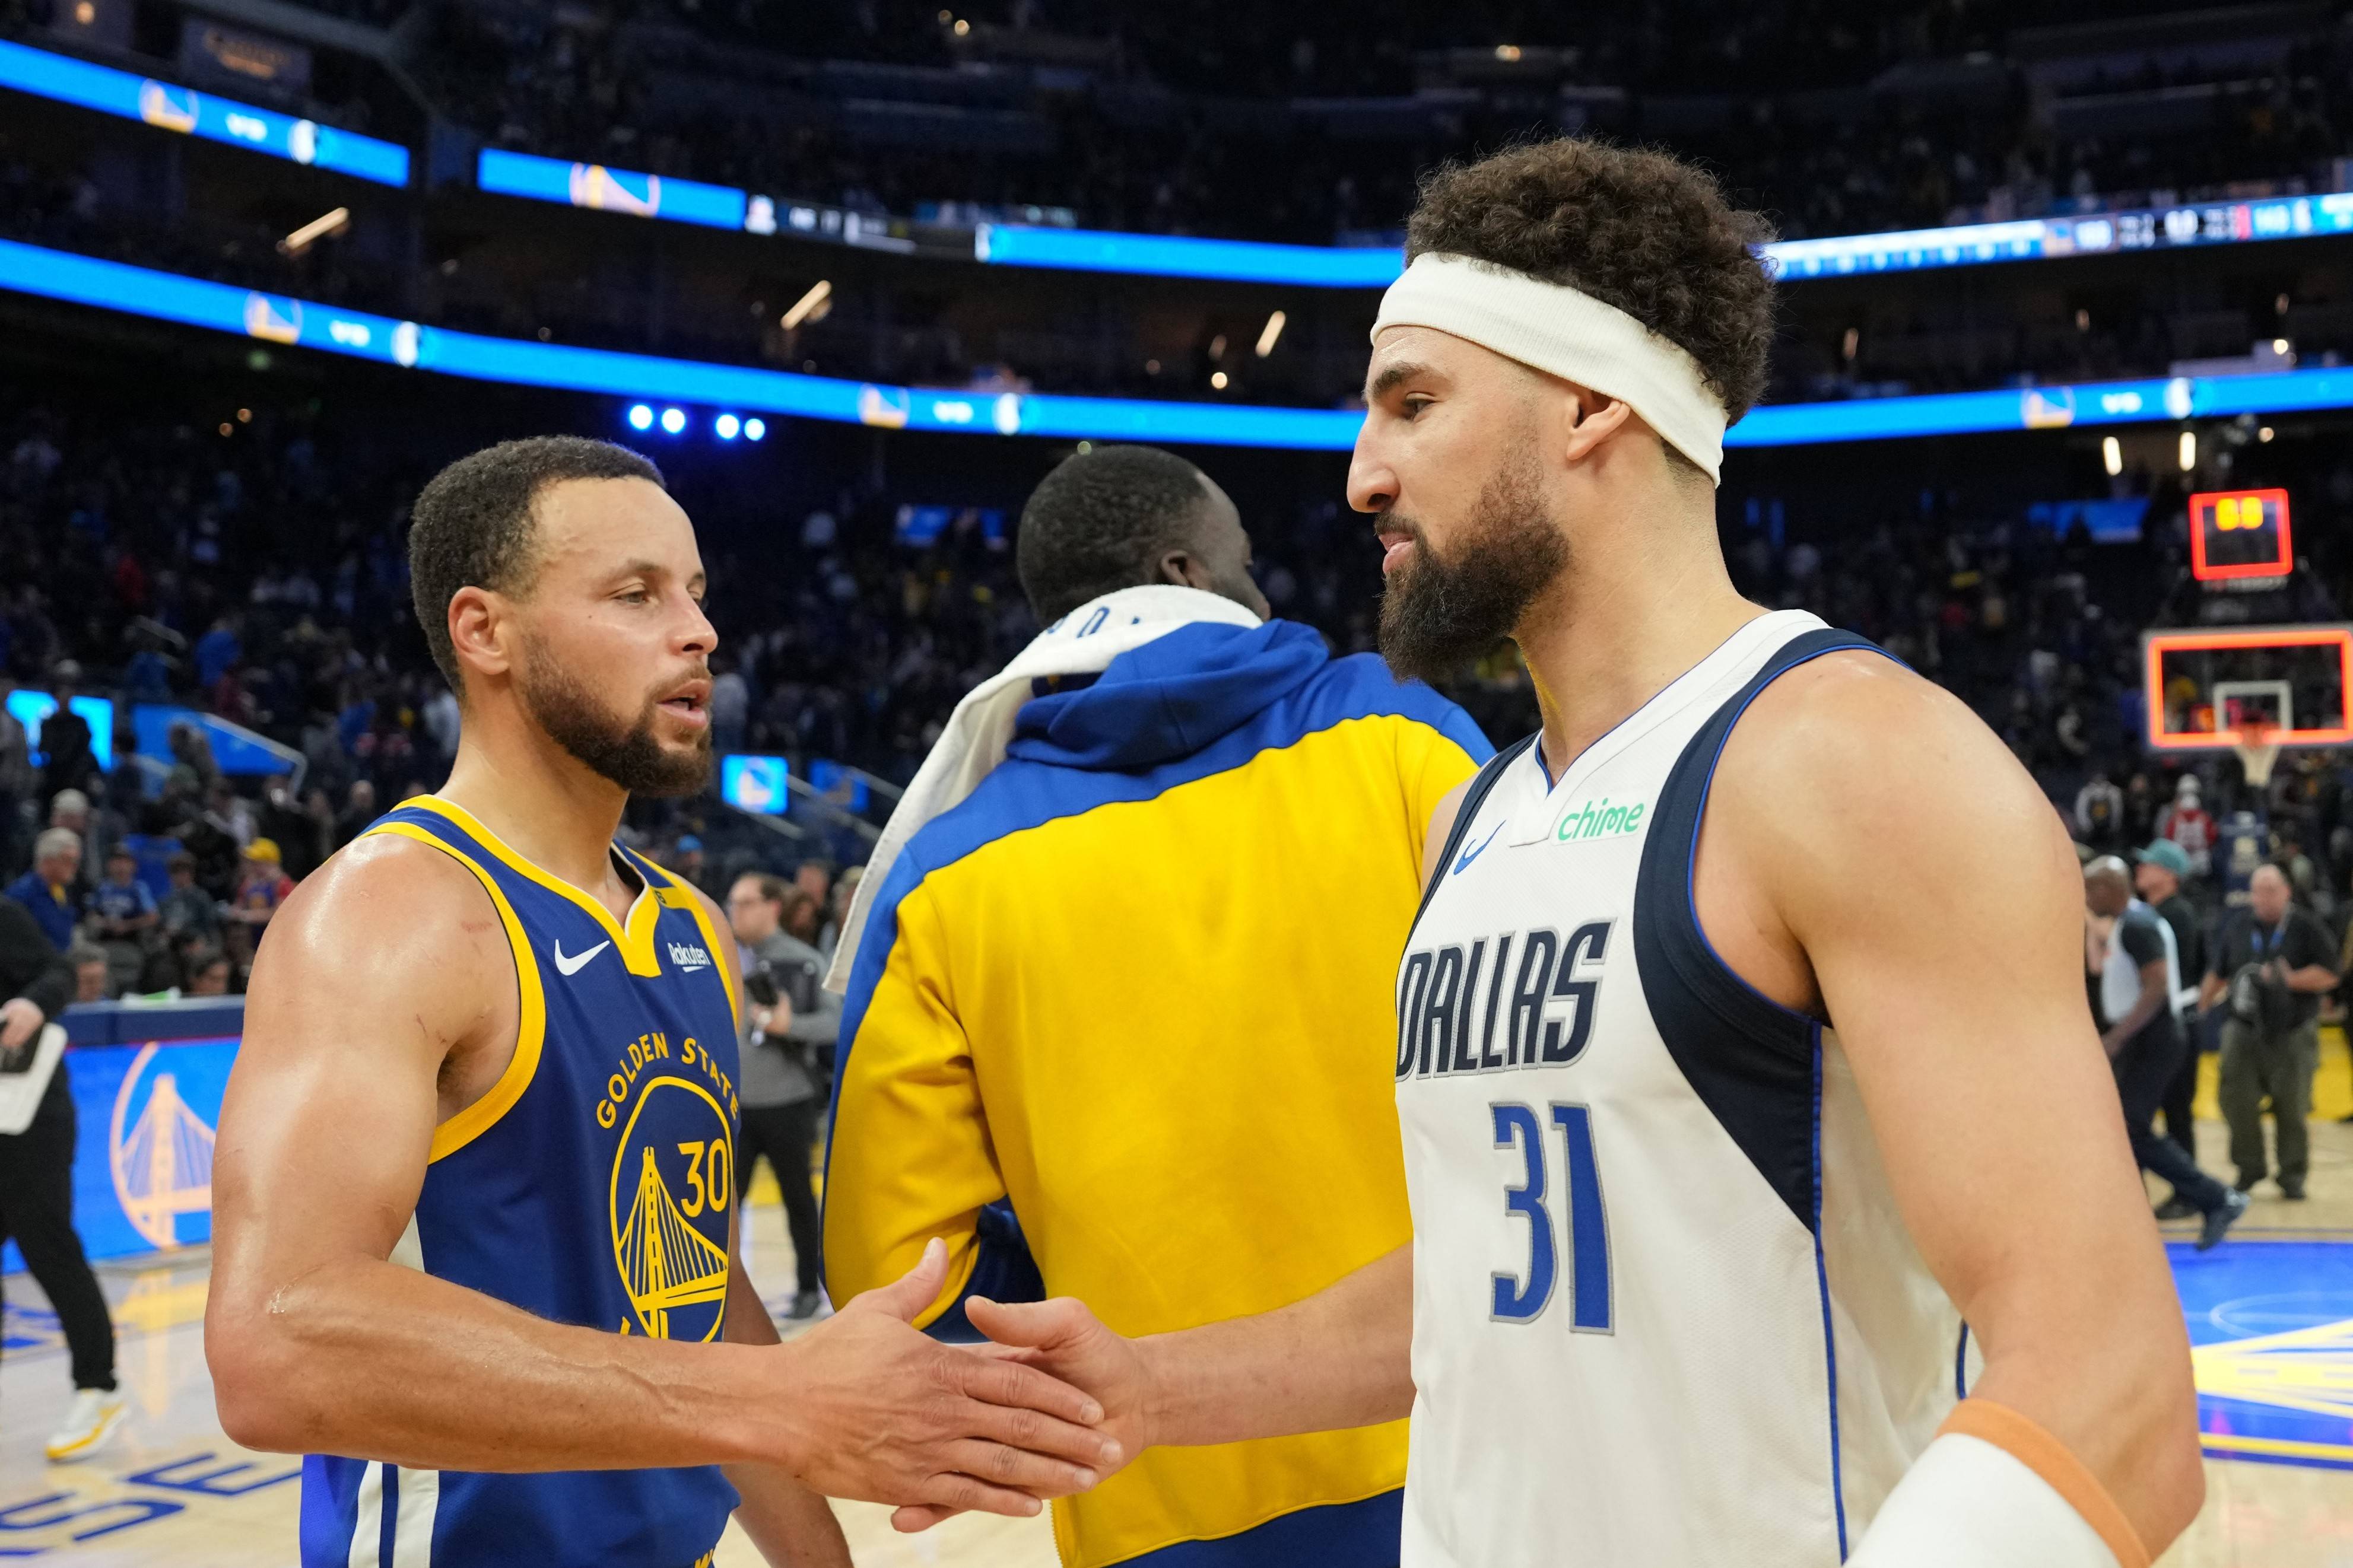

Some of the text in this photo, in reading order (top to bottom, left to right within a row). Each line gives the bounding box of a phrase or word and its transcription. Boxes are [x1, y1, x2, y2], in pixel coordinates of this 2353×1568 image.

[1558, 797, 1644, 841] chime
[667, 942, 711, 965] Rakuten
[1395, 917, 1618, 1083] DALLAS
[596, 1032, 739, 1129] GOLDEN STATE
[677, 1138, 729, 1218] 30
[1488, 1099, 1615, 1336] 31
